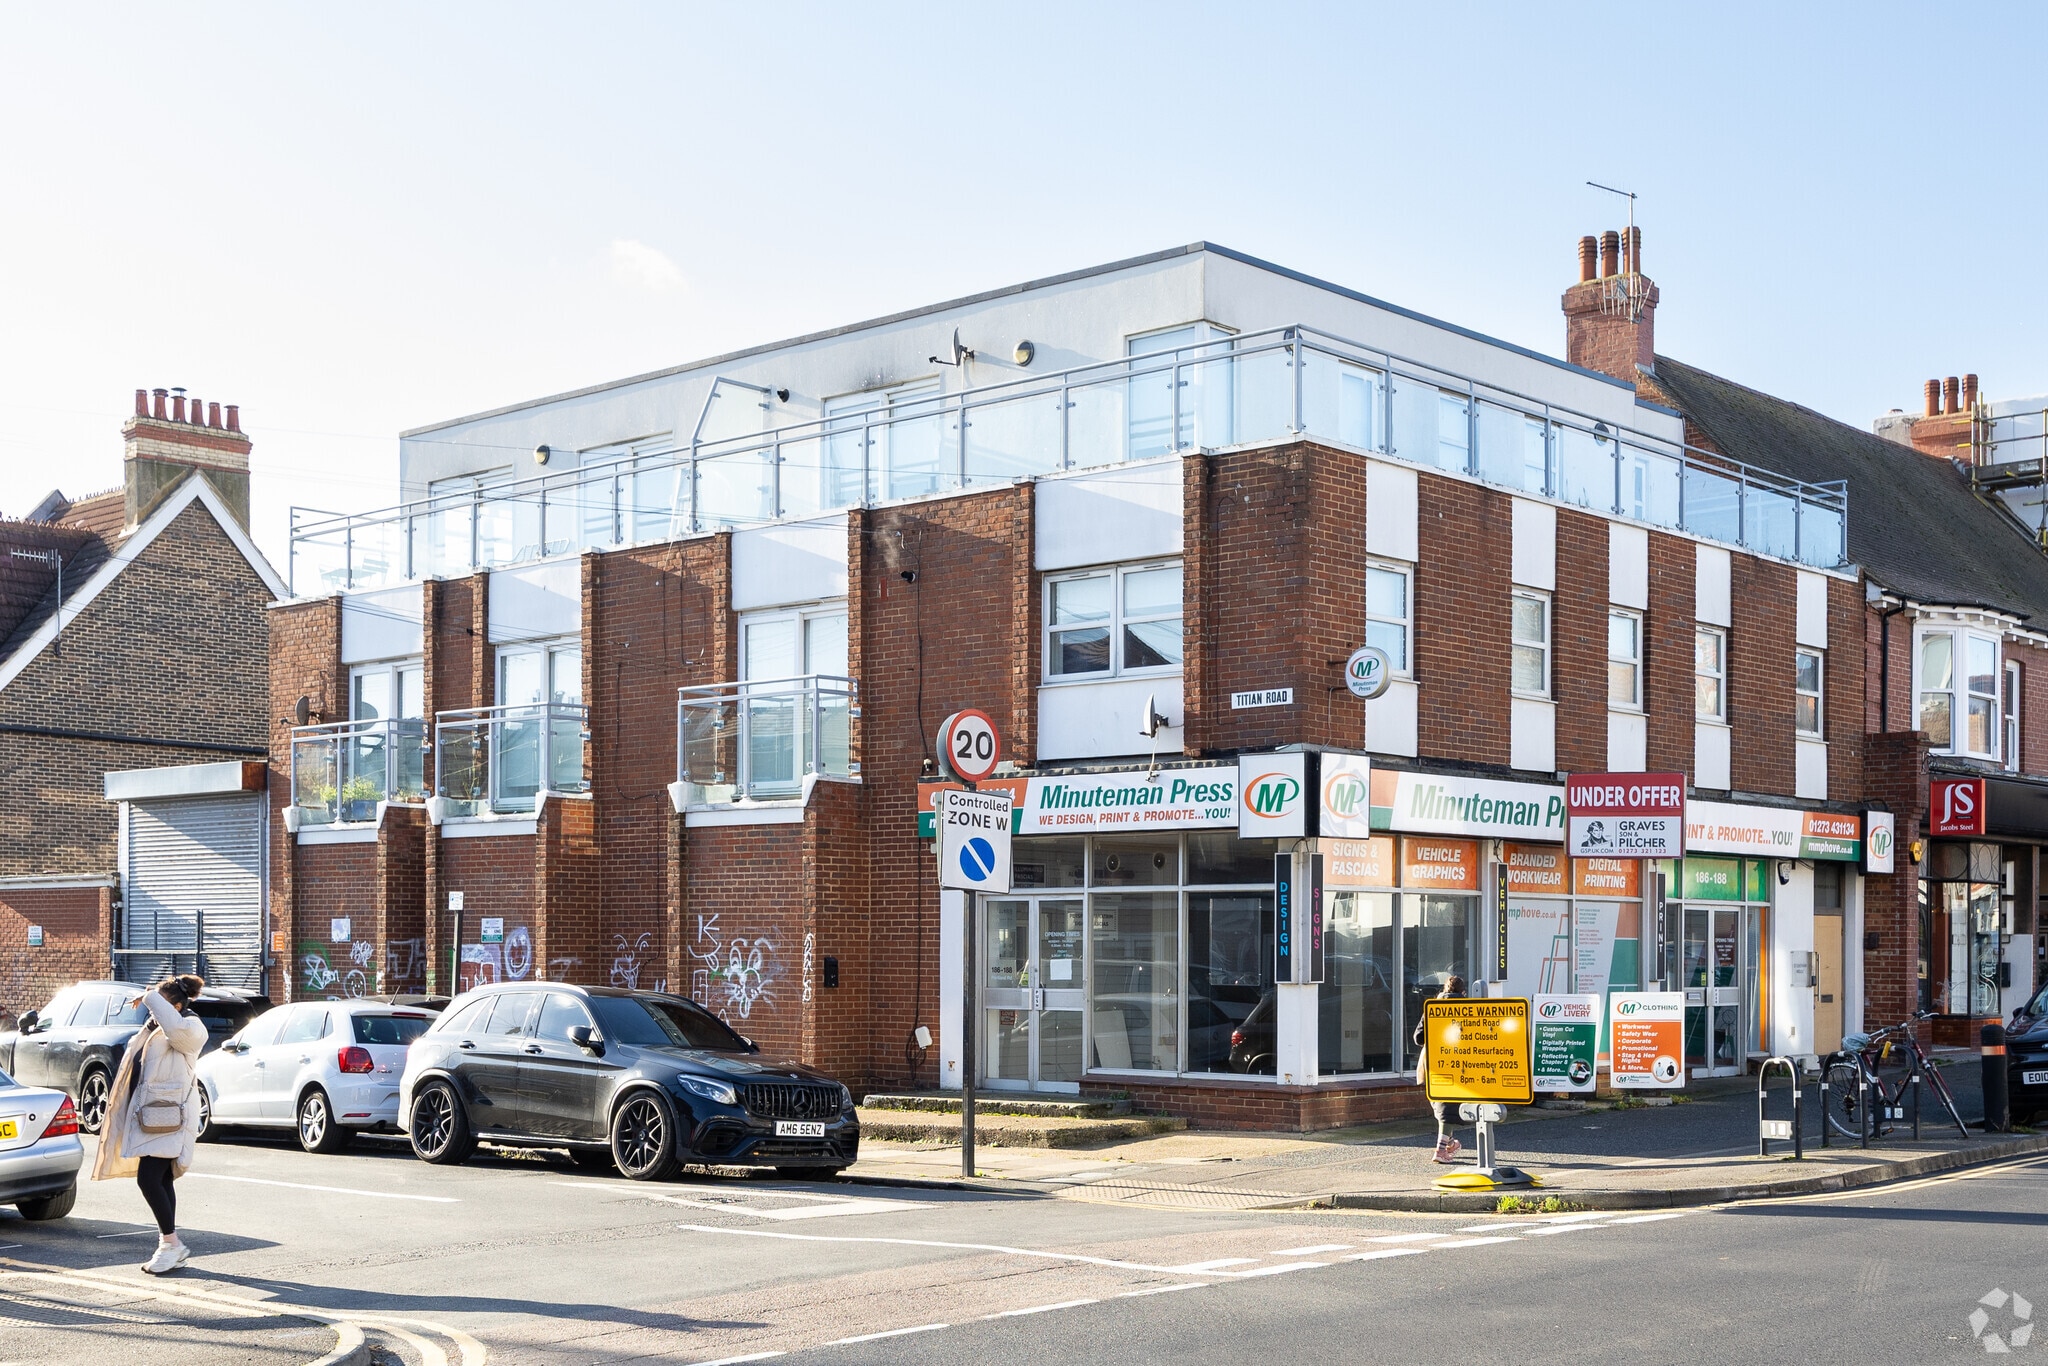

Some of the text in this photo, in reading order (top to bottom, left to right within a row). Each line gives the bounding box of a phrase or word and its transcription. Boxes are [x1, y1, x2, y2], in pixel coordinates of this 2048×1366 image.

[1236, 690, 1288, 707] TITIAN ROAD
[956, 730, 993, 760] 20
[1039, 784, 1164, 810] Minuteman
[1170, 778, 1234, 804] Press
[1570, 785, 1681, 808] UNDER OFFER
[949, 794, 1009, 812] Controlled
[1410, 783, 1540, 828] Minuteman
[1940, 783, 1974, 824] JS
[948, 810, 991, 829] ZONE
[996, 817, 1009, 831] W
[1039, 814, 1054, 826] WE
[1056, 813, 1097, 826] DESIGN,
[1099, 811, 1131, 824] PRINT
[1132, 811, 1141, 822] &
[1619, 821, 1666, 831] GRAVES
[1686, 823, 1705, 840] INT
[1707, 825, 1714, 839] &
[1808, 819, 1855, 836] 01273 431134
[1940, 824, 1958, 832] Jacobs
[1332, 842, 1379, 859] SIGNS &
[1619, 838, 1666, 848] PILCHER
[1808, 841, 1853, 855] mmphove.co.uk
[1416, 846, 1462, 863] VEHICLE
[1509, 852, 1557, 868] BRANDED
[1331, 860, 1380, 877] FASCIAS
[1411, 864, 1466, 881] GRAPHICS
[1588, 858, 1622, 873] DIGITAL
[1507, 869, 1562, 886] WORKWEAR
[1584, 874, 1627, 889] PRINTING
[1695, 871, 1728, 885] 186-188
[1279, 881, 1289, 957] DESIGN
[1313, 887, 1321, 950] SIGNS
[1508, 906, 1557, 920] mphove.co.uk
[1428, 1006, 1524, 1017] ADVANCE WARNING
[1482, 1019, 1500, 1027] Road
[1460, 1033, 1498, 1041] oad Closed
[1440, 1047, 1514, 1057] For Road Resurfacing
[1437, 1060, 1444, 1068] 17
[1450, 1060, 1460, 1068] 28
[1462, 1060, 1497, 1069] November
[1499, 1061, 1519, 1069] 2025
[1460, 1076, 1475, 1084] 8pm
[1481, 1076, 1497, 1084] 6am
[780, 1123, 822, 1136] AH6 5ENZ
